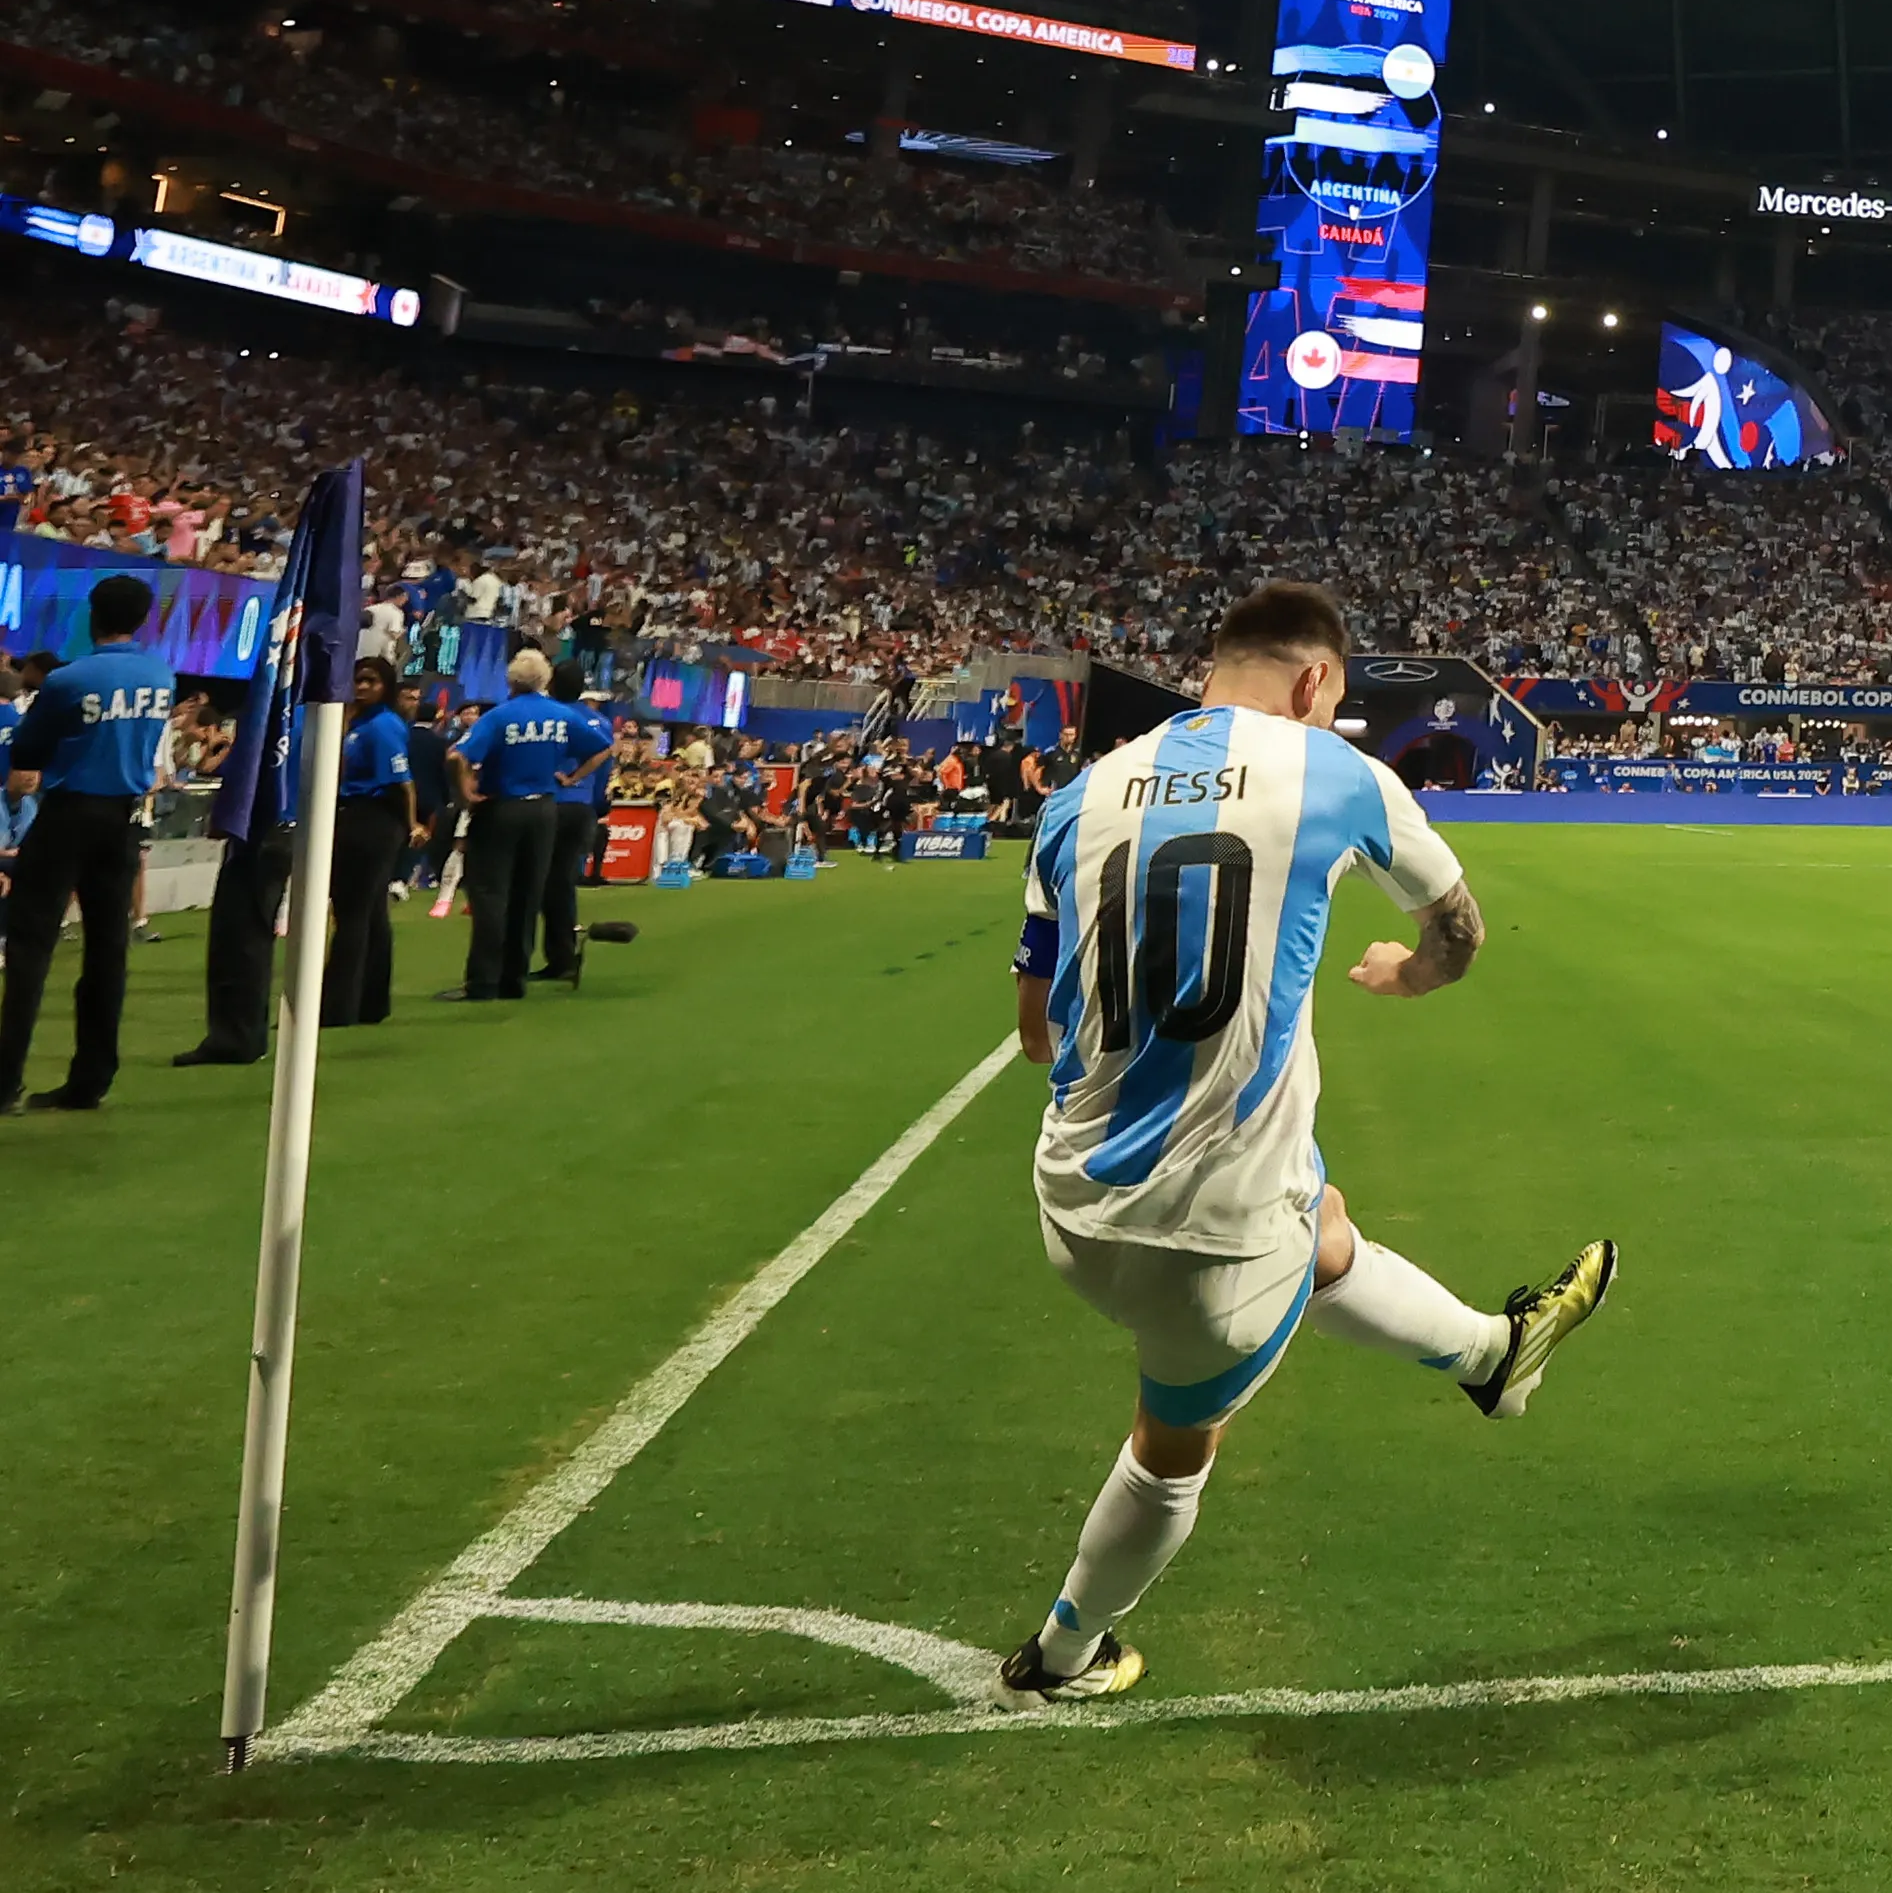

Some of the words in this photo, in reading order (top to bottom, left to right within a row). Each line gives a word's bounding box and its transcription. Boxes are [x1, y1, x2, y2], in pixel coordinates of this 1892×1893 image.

[975, 11, 1032, 39] COPA
[1033, 22, 1124, 55] AMERICA
[1310, 179, 1402, 207] ARGENTINA
[1738, 688, 1849, 707] CONMEBOL
[1122, 764, 1248, 811] MESSI
[1683, 767, 1716, 780] COPA
[1773, 769, 1796, 781] USA
[915, 835, 965, 851] VIBRA
[1098, 831, 1253, 1054] 10
